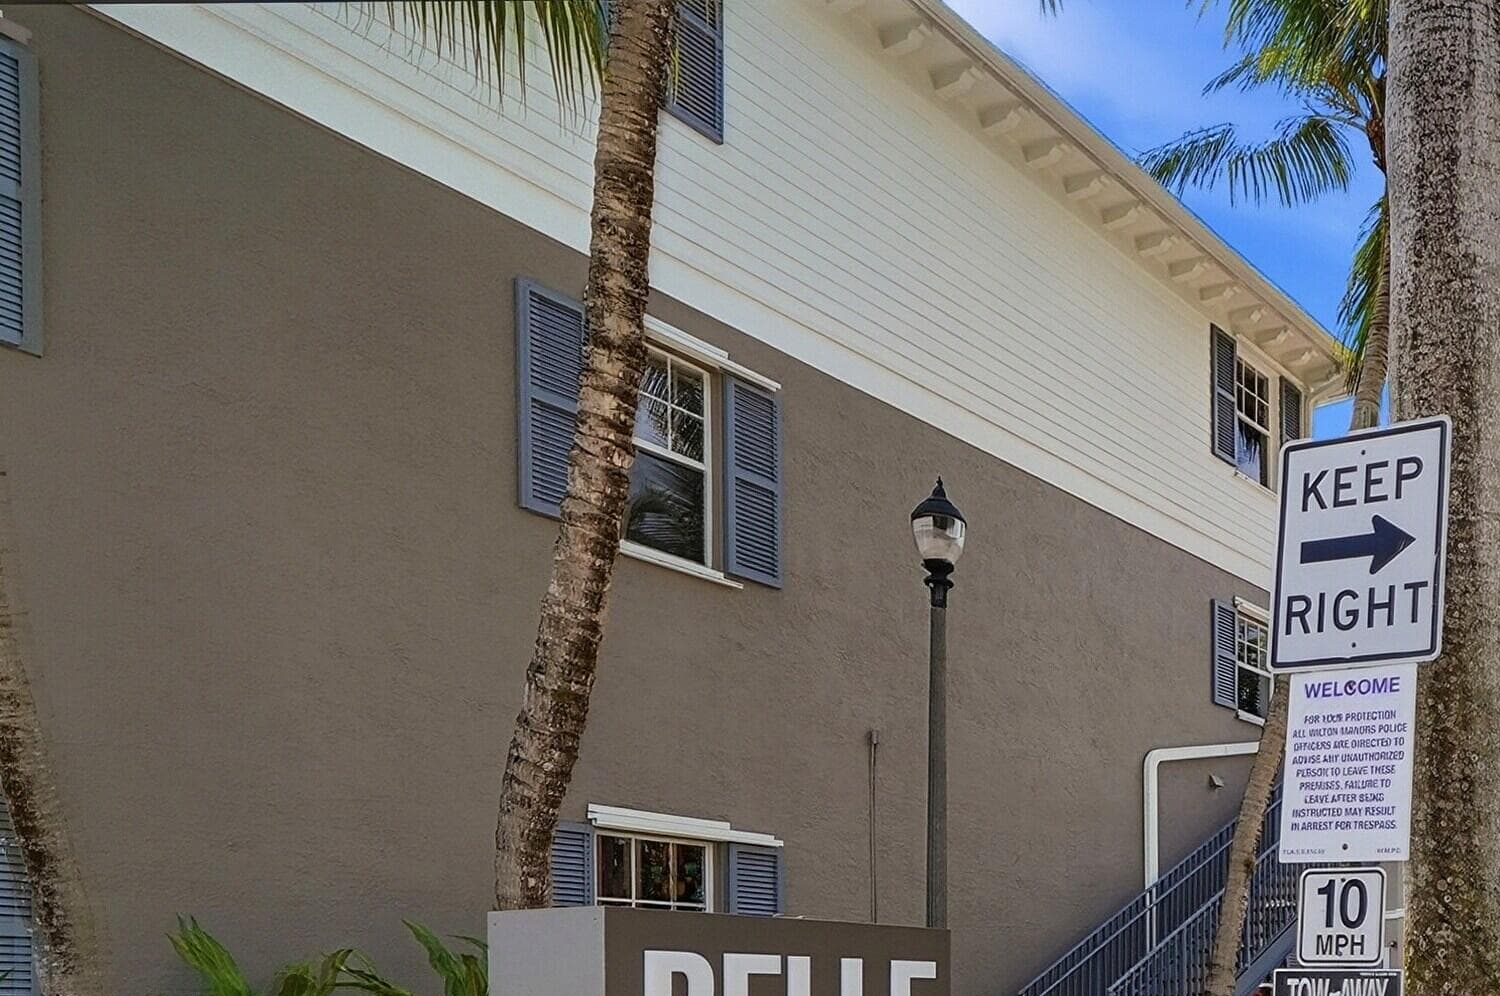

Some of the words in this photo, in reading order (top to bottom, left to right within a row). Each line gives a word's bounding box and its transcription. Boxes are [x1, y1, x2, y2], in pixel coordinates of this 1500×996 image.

[1301, 455, 1424, 513] KEEP
[1284, 580, 1429, 636] RIGHT
[1304, 676, 1401, 699] WELCOME
[1304, 714, 1320, 724] FOR
[1345, 710, 1397, 722] PROTECTION
[1292, 729, 1307, 738] ALL
[1308, 727, 1339, 738] WILTON
[1341, 725, 1377, 736] MANORS
[1378, 722, 1408, 734] POLICE
[1293, 741, 1332, 752] OFFICERS
[1333, 740, 1350, 750] ARE
[1351, 738, 1392, 748] DIRECTED
[1394, 737, 1405, 746] TO
[1292, 754, 1321, 765] ADVISE
[1322, 753, 1340, 763] ANY
[1341, 750, 1405, 763] UNAUTHORIZED
[1296, 767, 1329, 778] PERSON
[1331, 767, 1341, 777] TO
[1342, 765, 1368, 776] LEAVE
[1370, 765, 1396, 774] THESE
[1344, 779, 1379, 789] FAILURE
[1381, 779, 1391, 788] TO
[1304, 794, 1329, 804] LEAVE
[1331, 793, 1357, 803] AFTER
[1359, 792, 1385, 802] BEING
[1292, 807, 1342, 818] INSTRUCTED
[1344, 807, 1363, 817] MAY
[1364, 806, 1396, 816] RESULT
[1291, 822, 1300, 831] IN
[1301, 821, 1333, 831] ARREST
[1334, 821, 1352, 830] FOR
[1317, 878, 1368, 929] 10
[1315, 934, 1365, 956] MPH
